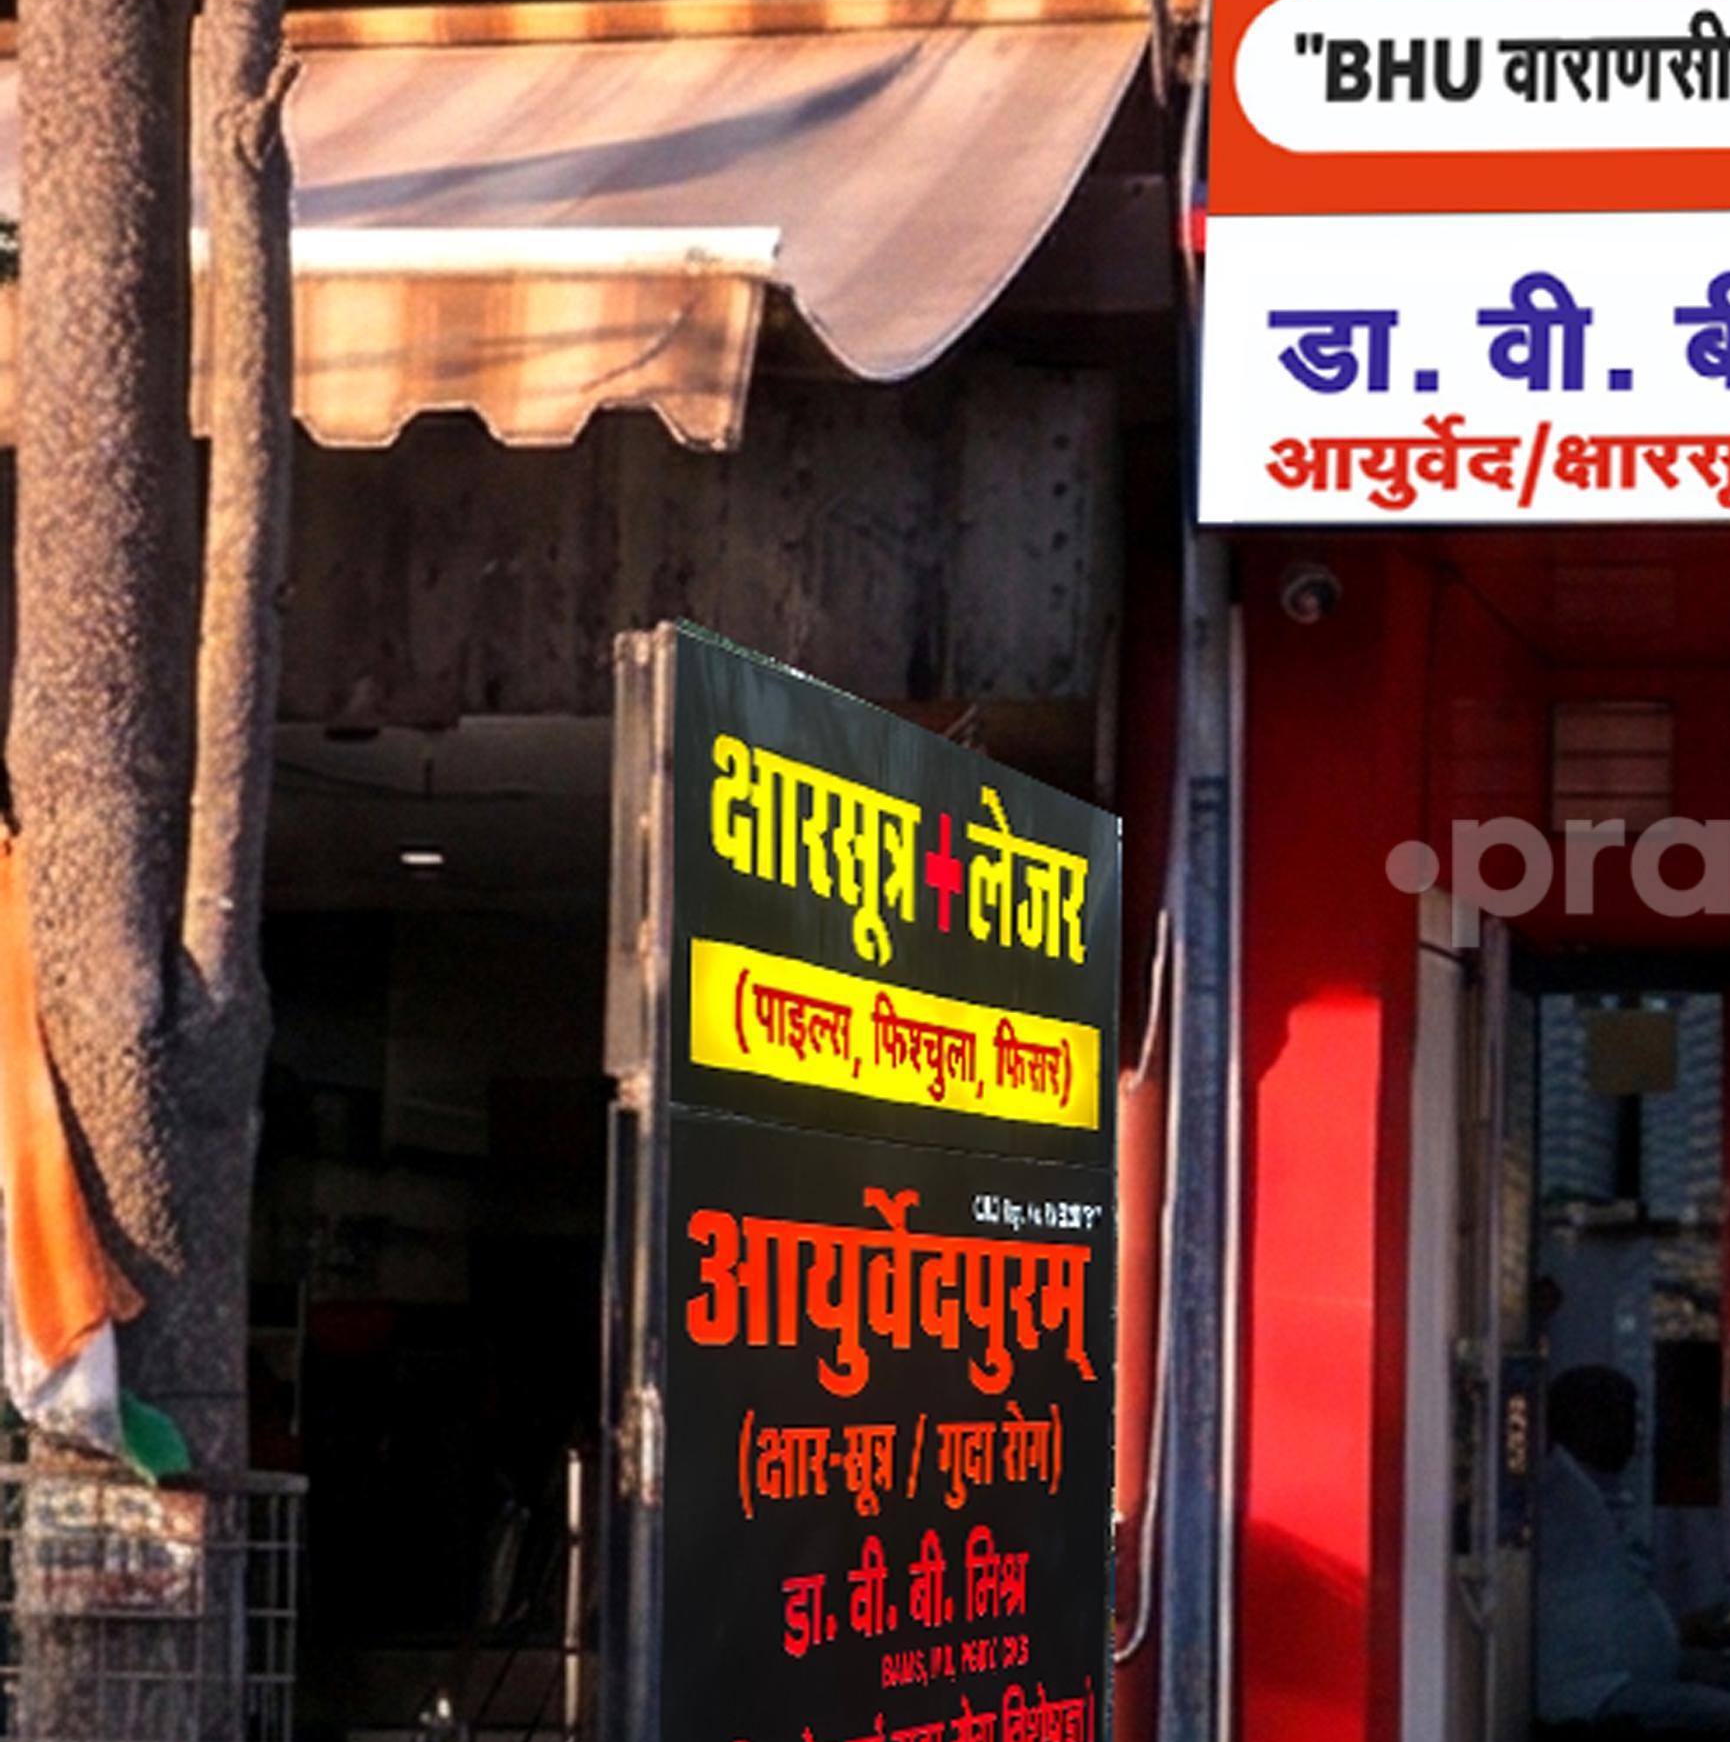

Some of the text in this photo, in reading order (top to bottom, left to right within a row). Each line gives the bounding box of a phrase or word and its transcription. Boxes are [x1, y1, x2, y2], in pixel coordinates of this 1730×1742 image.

[1294, 31, 1483, 104] "BHU
[710, 734, 921, 967] क्षारसूत्र
[966, 785, 1088, 964] लेजर
[734, 967, 861, 1078] (पाइल्स,
[994, 1017, 1071, 1108] फिसर)
[685, 1187, 1096, 1397] आयुर्वेदपुरम्
[937, 1419, 995, 1510] गुदा
[1001, 1400, 1064, 1496] रोग)
[963, 1525, 1031, 1624] मिश्र
